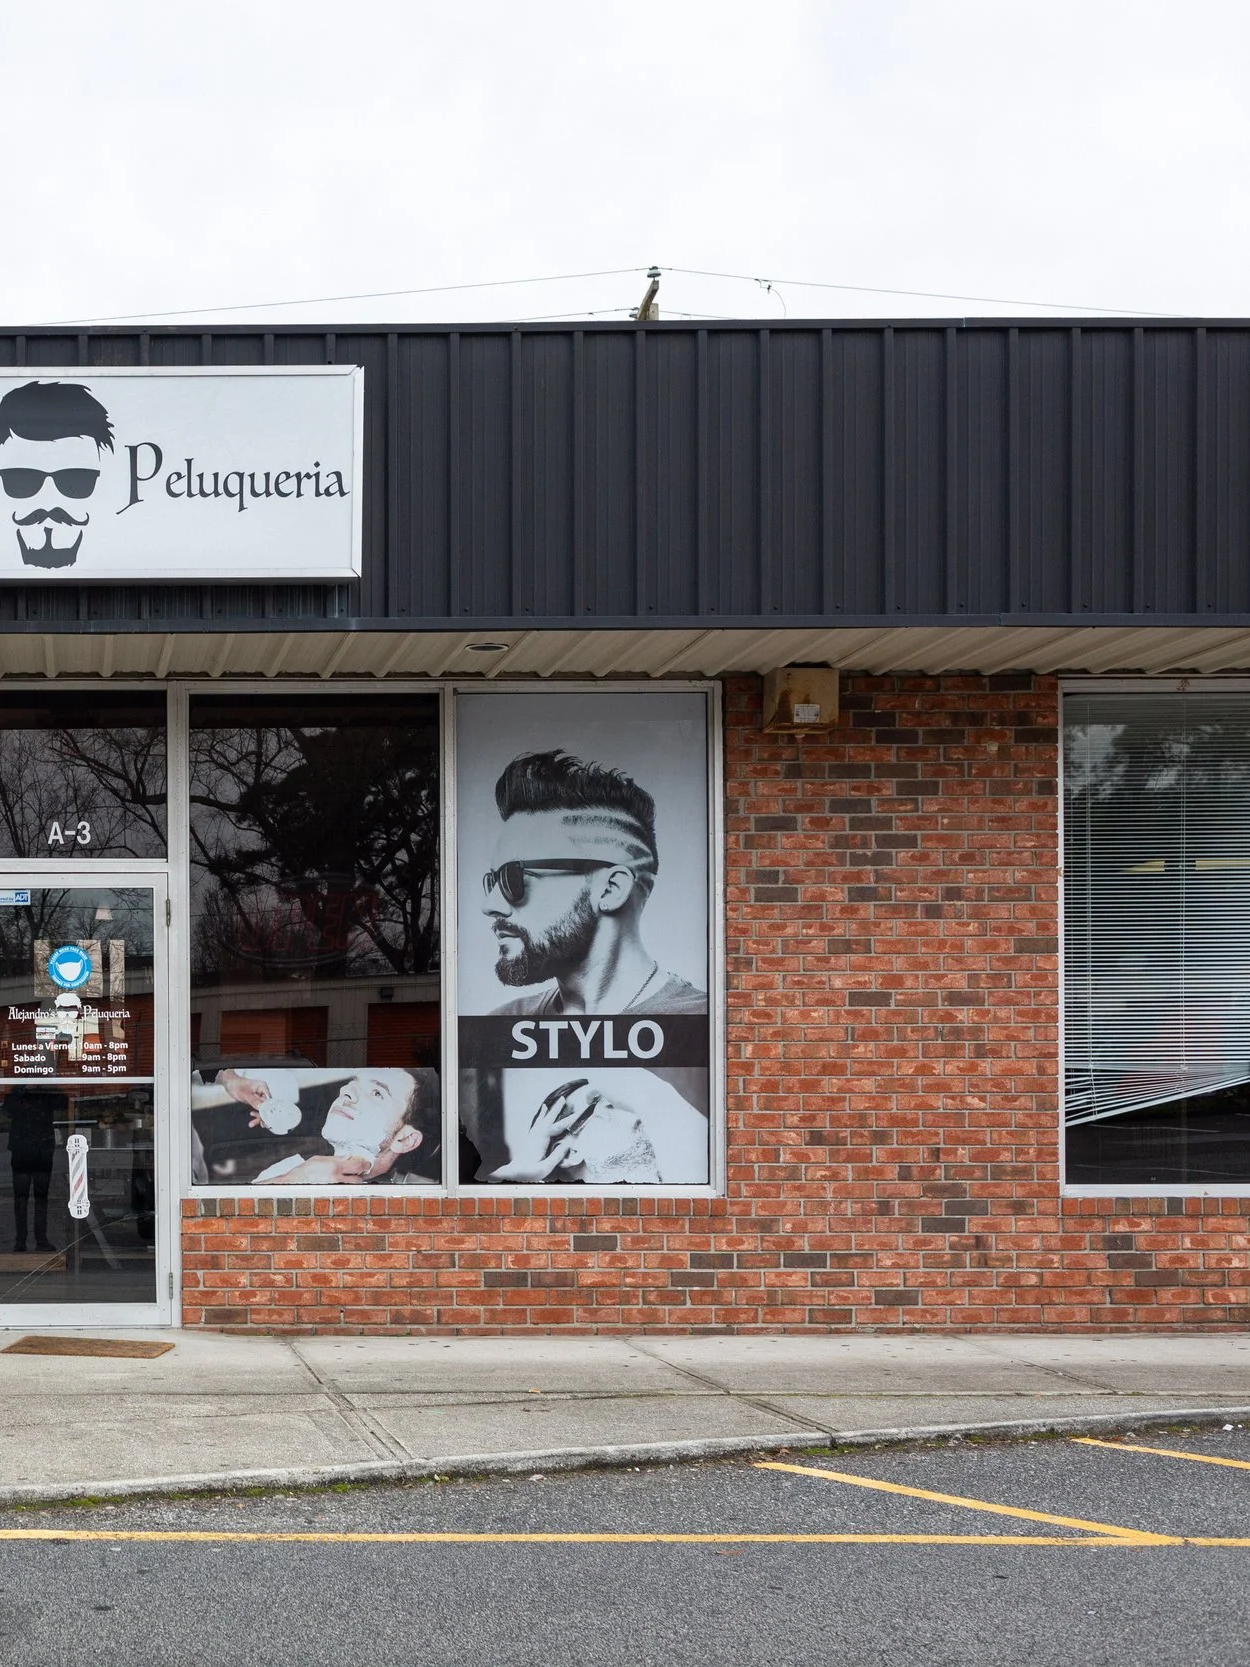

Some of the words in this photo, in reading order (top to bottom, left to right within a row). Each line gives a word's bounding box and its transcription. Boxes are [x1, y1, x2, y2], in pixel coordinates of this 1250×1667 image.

[117, 442, 351, 515] Peluqueria
[47, 820, 91, 844] A-3
[15, 892, 28, 902] ADT
[8, 1006, 56, 1023] Alejandro's
[81, 1004, 131, 1021] Peluqueria
[11, 1043, 37, 1051] Lunes
[109, 1042, 129, 1052] 8pm
[510, 1019, 665, 1060] STYLO
[13, 1054, 46, 1062] Sabado
[81, 1053, 101, 1061] 9am
[107, 1053, 127, 1063] 8pm
[14, 1065, 54, 1075] Domingo
[107, 1064, 127, 1074] 5pm
